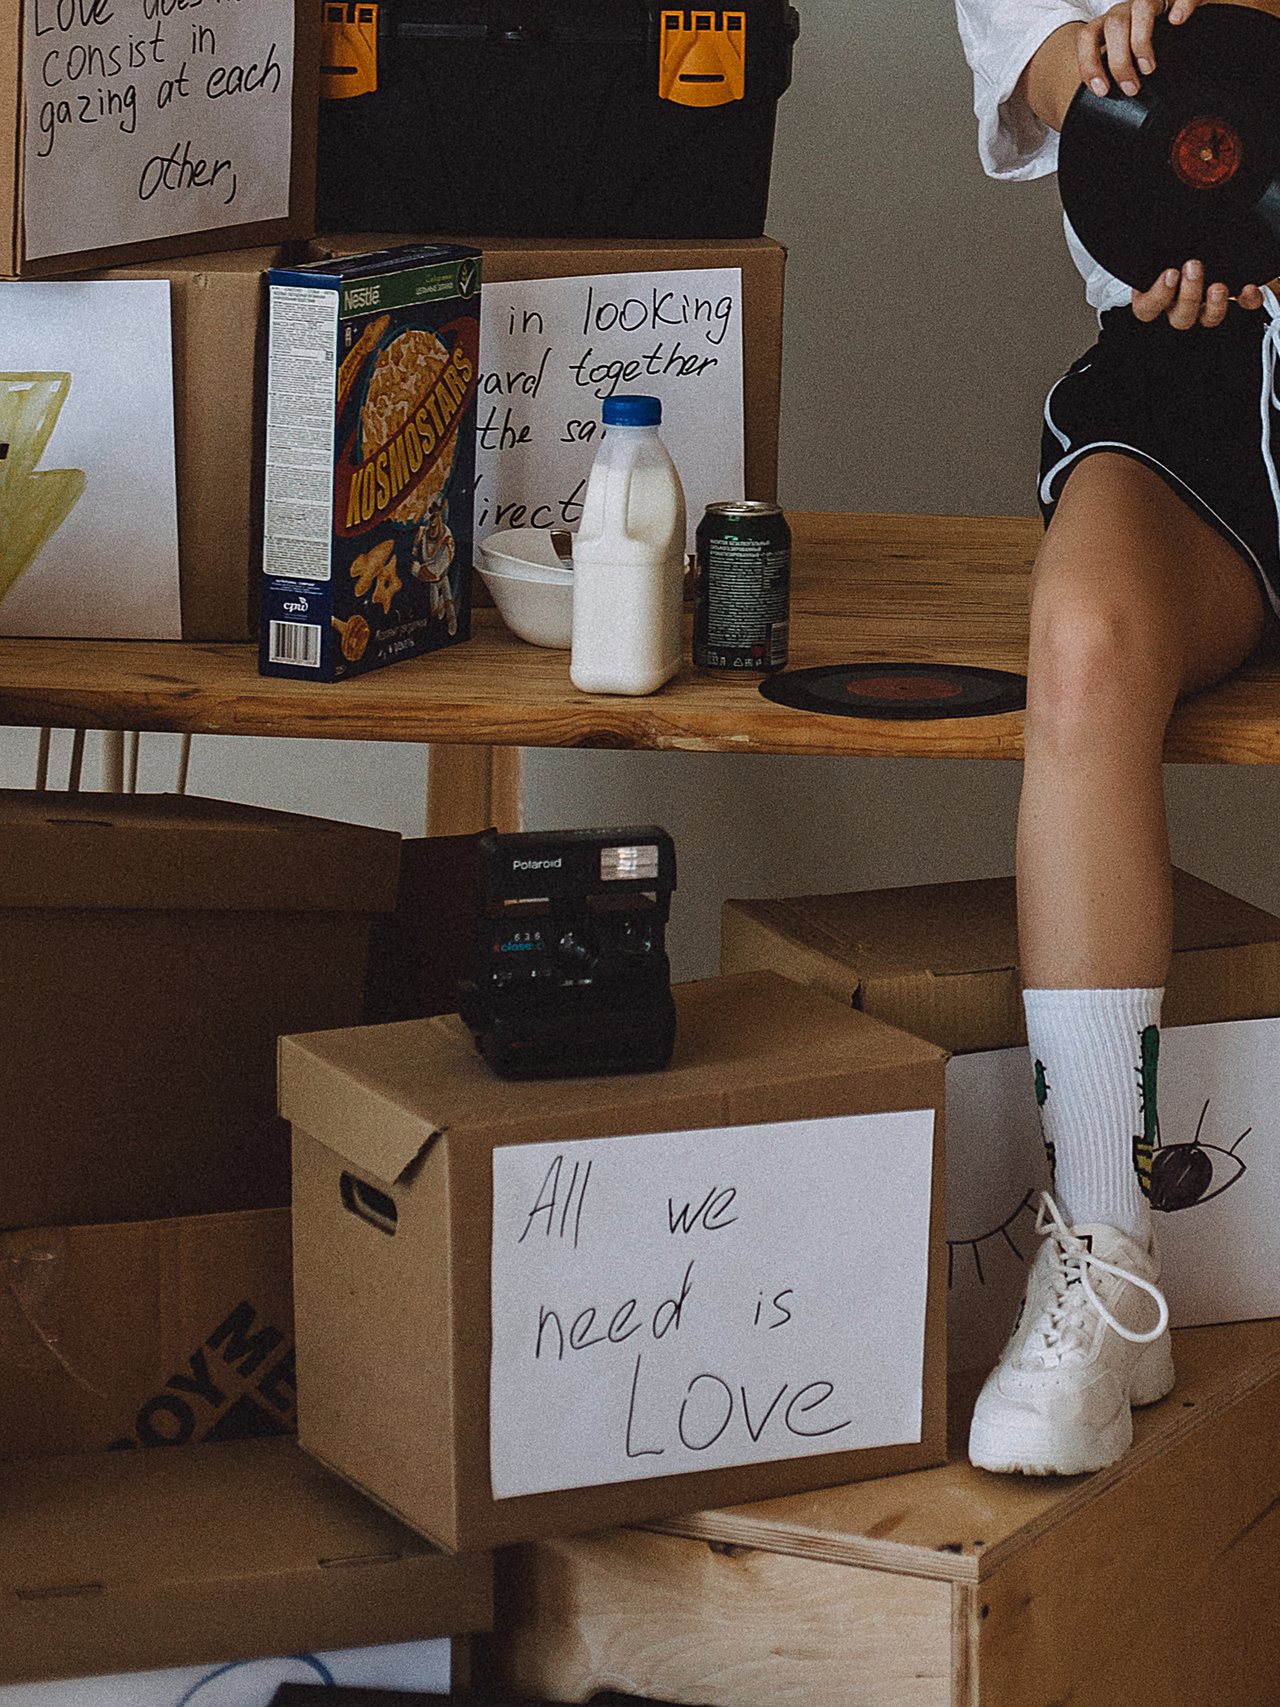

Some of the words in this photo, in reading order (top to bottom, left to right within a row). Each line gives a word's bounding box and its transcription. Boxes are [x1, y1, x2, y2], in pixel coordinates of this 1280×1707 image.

[43, 20, 165, 87] consist
[191, 24, 215, 54] in
[37, 84, 137, 157] gazing
[157, 62, 189, 109] at
[207, 43, 281, 99] each
[509, 306, 544, 335] in
[569, 342, 718, 399] together
[345, 345, 474, 529] KOSMOSTARS
[476, 405, 533, 450] the
[560, 419, 606, 443] sa
[475, 474, 586, 530] irect
[513, 858, 562, 871] Polaroid
[518, 1155, 592, 1249] All
[668, 1187, 738, 1234] we
[535, 1260, 694, 1360] need
[754, 1289, 794, 1329] is
